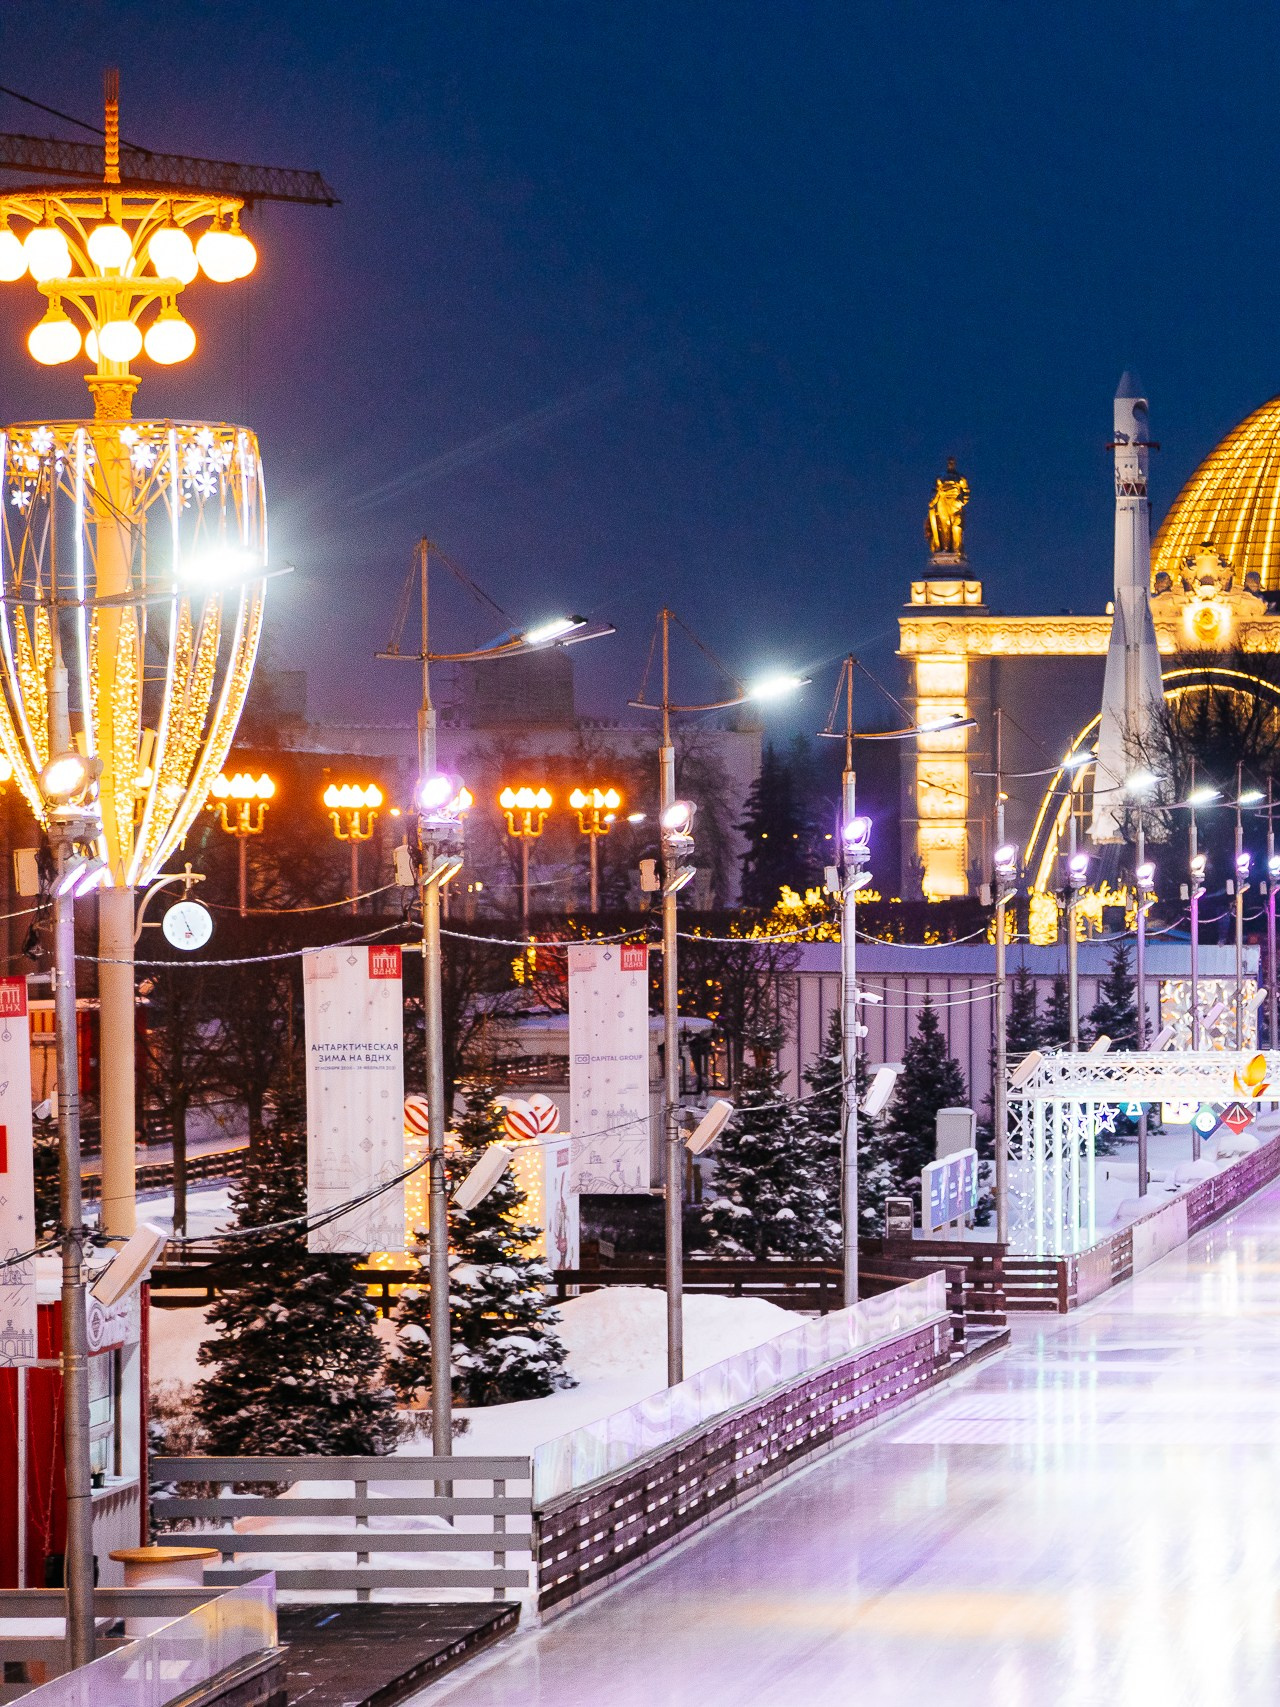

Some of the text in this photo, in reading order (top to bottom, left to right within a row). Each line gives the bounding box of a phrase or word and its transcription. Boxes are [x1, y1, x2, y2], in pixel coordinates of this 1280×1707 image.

[373, 968, 397, 976] ВДНХ
[0, 1003, 21, 1013] ДНХ
[311, 1043, 399, 1051] АНТАРКТИЧЕСКАЯ
[319, 1054, 392, 1062] ЗИМА НА ВДНХ
